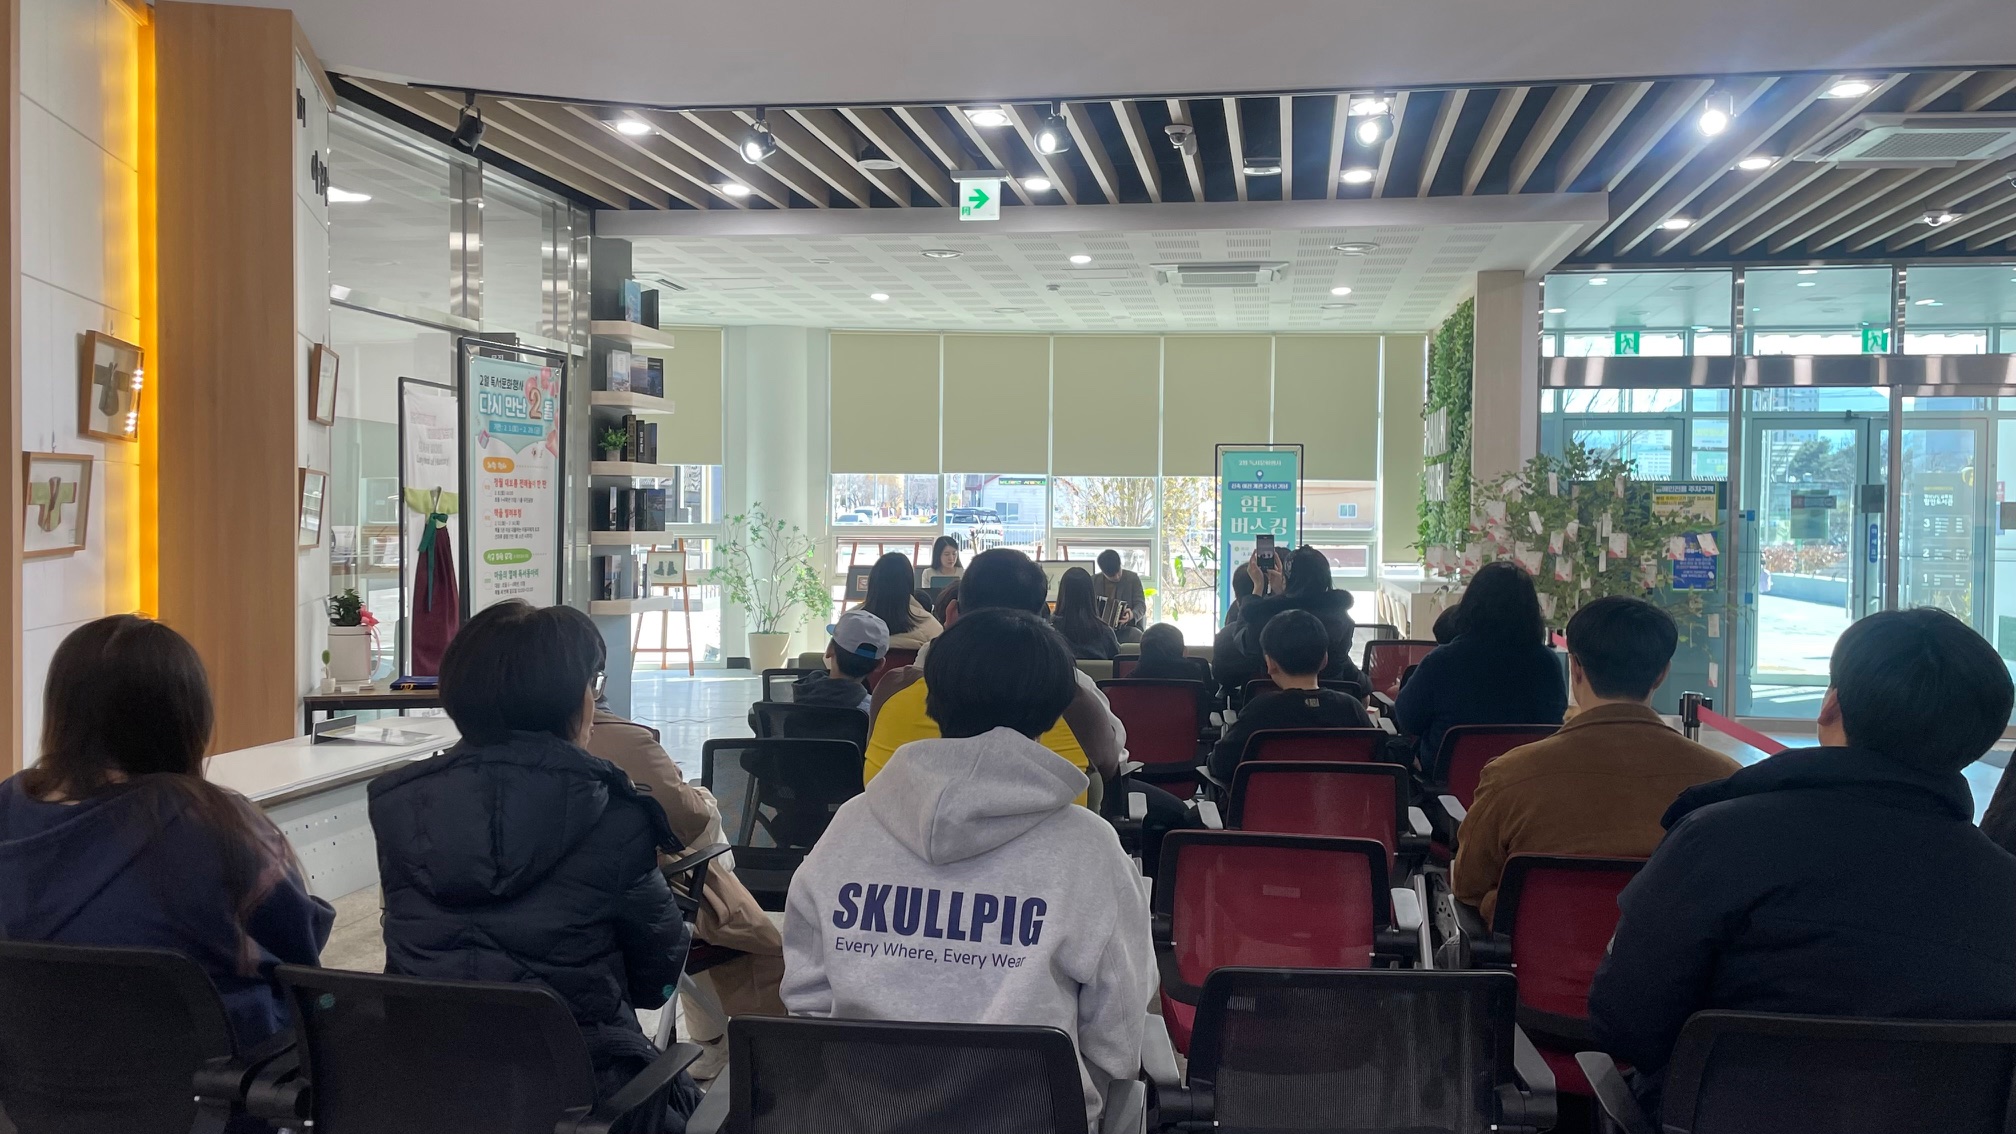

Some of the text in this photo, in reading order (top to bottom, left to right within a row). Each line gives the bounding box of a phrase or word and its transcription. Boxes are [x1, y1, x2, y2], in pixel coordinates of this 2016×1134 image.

[480, 375, 524, 391] 2월 독서문화행사
[479, 393, 502, 416] 다시
[505, 396, 527, 418] 만난
[1241, 495, 1278, 513] 함도
[1231, 517, 1287, 537] 버스킹
[1923, 518, 1930, 527] 3
[1922, 548, 1929, 557] 2
[1923, 573, 1928, 583] 1
[832, 882, 1047, 947] SKULLPIG
[835, 937, 1026, 969] Every Where, Every Wear
